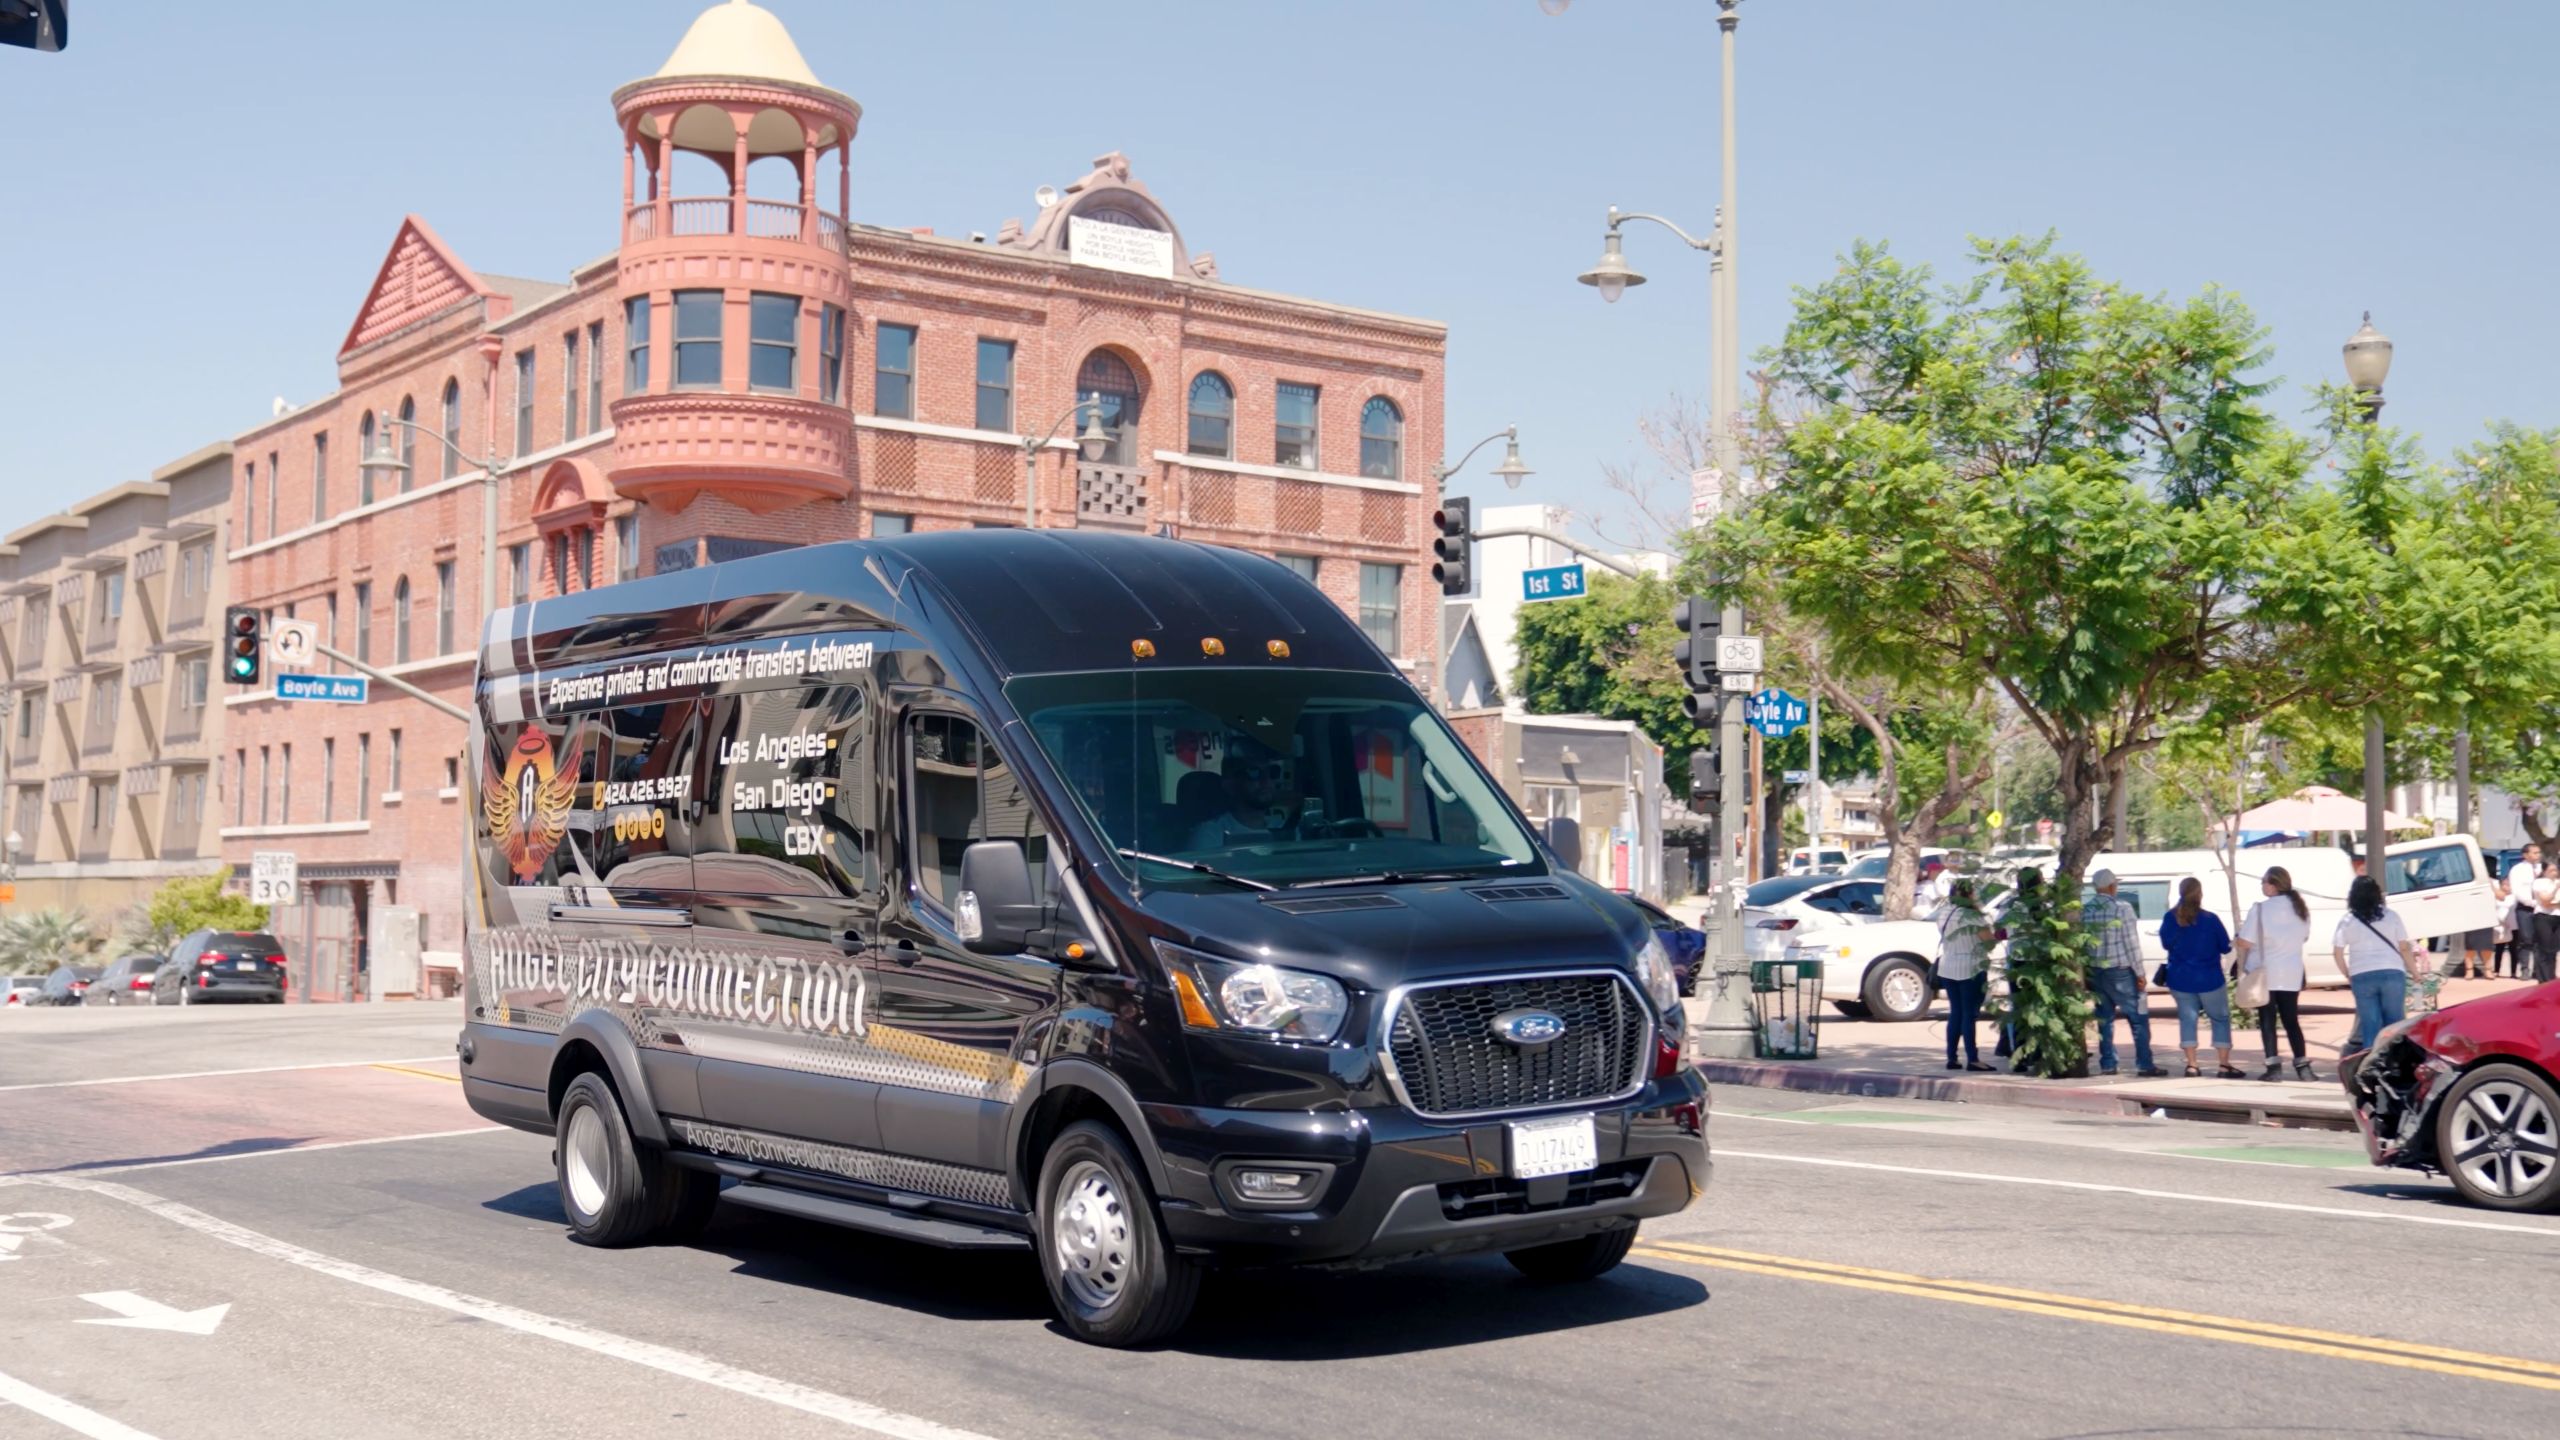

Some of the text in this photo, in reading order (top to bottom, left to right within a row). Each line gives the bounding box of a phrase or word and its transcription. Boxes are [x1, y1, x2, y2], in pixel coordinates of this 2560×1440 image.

[1529, 572, 1578, 594] 1st St
[284, 679, 359, 698] Boyle Ave
[550, 637, 874, 711] Experience private and comfortable transfers between
[1745, 700, 1803, 725] Boyle Av
[720, 726, 827, 769] Los Angeles
[604, 774, 692, 806] 424.426.9927
[733, 776, 825, 816] San Diego
[784, 824, 825, 856] CBX
[258, 880, 291, 899] 30
[488, 930, 867, 1037] ANGEL CITY CONNECTION
[1519, 1017, 1555, 1038] Ford
[685, 1121, 878, 1179] Angelcityconnection.com
